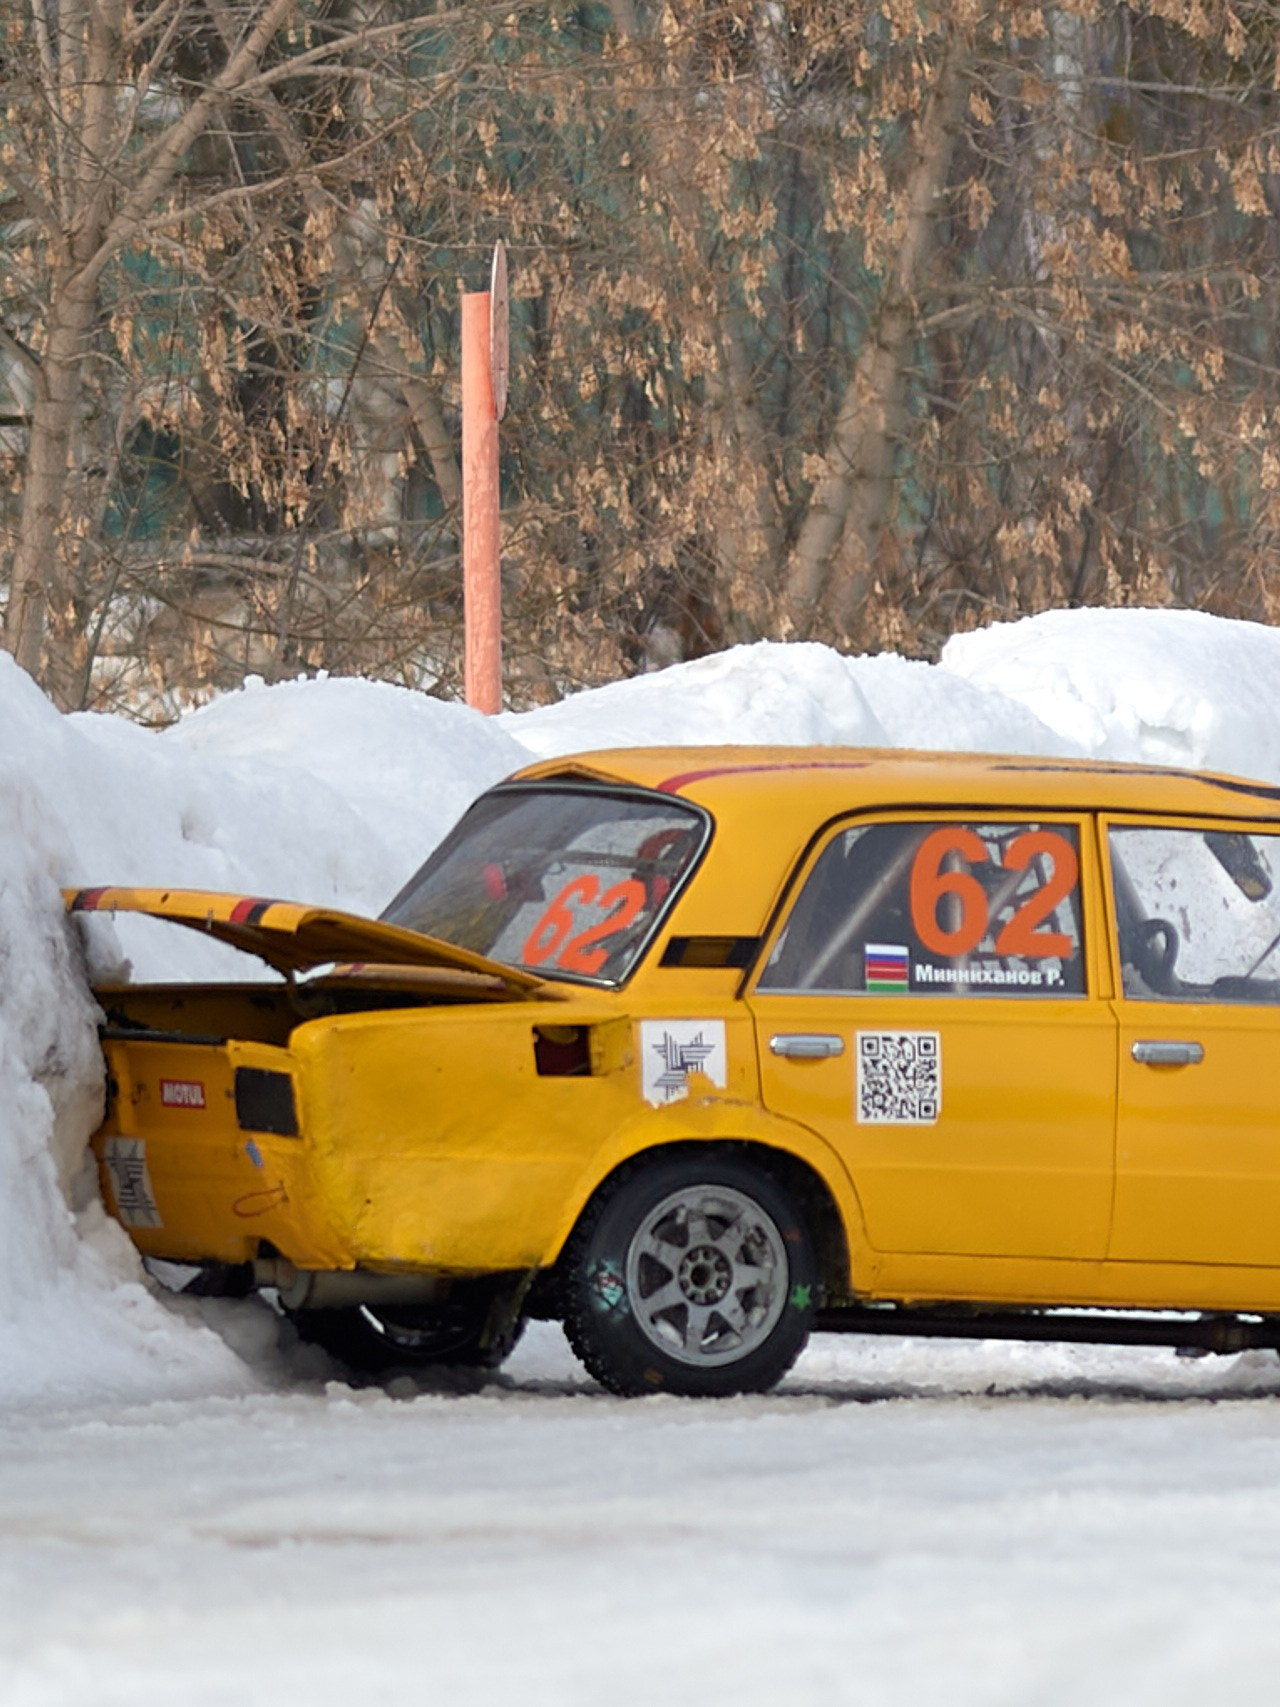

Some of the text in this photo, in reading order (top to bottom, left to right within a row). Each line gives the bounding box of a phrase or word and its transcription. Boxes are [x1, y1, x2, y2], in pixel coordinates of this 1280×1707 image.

[522, 873, 646, 975] 62
[910, 827, 1078, 958] 62
[915, 964, 1065, 986] Минниханов Р.
